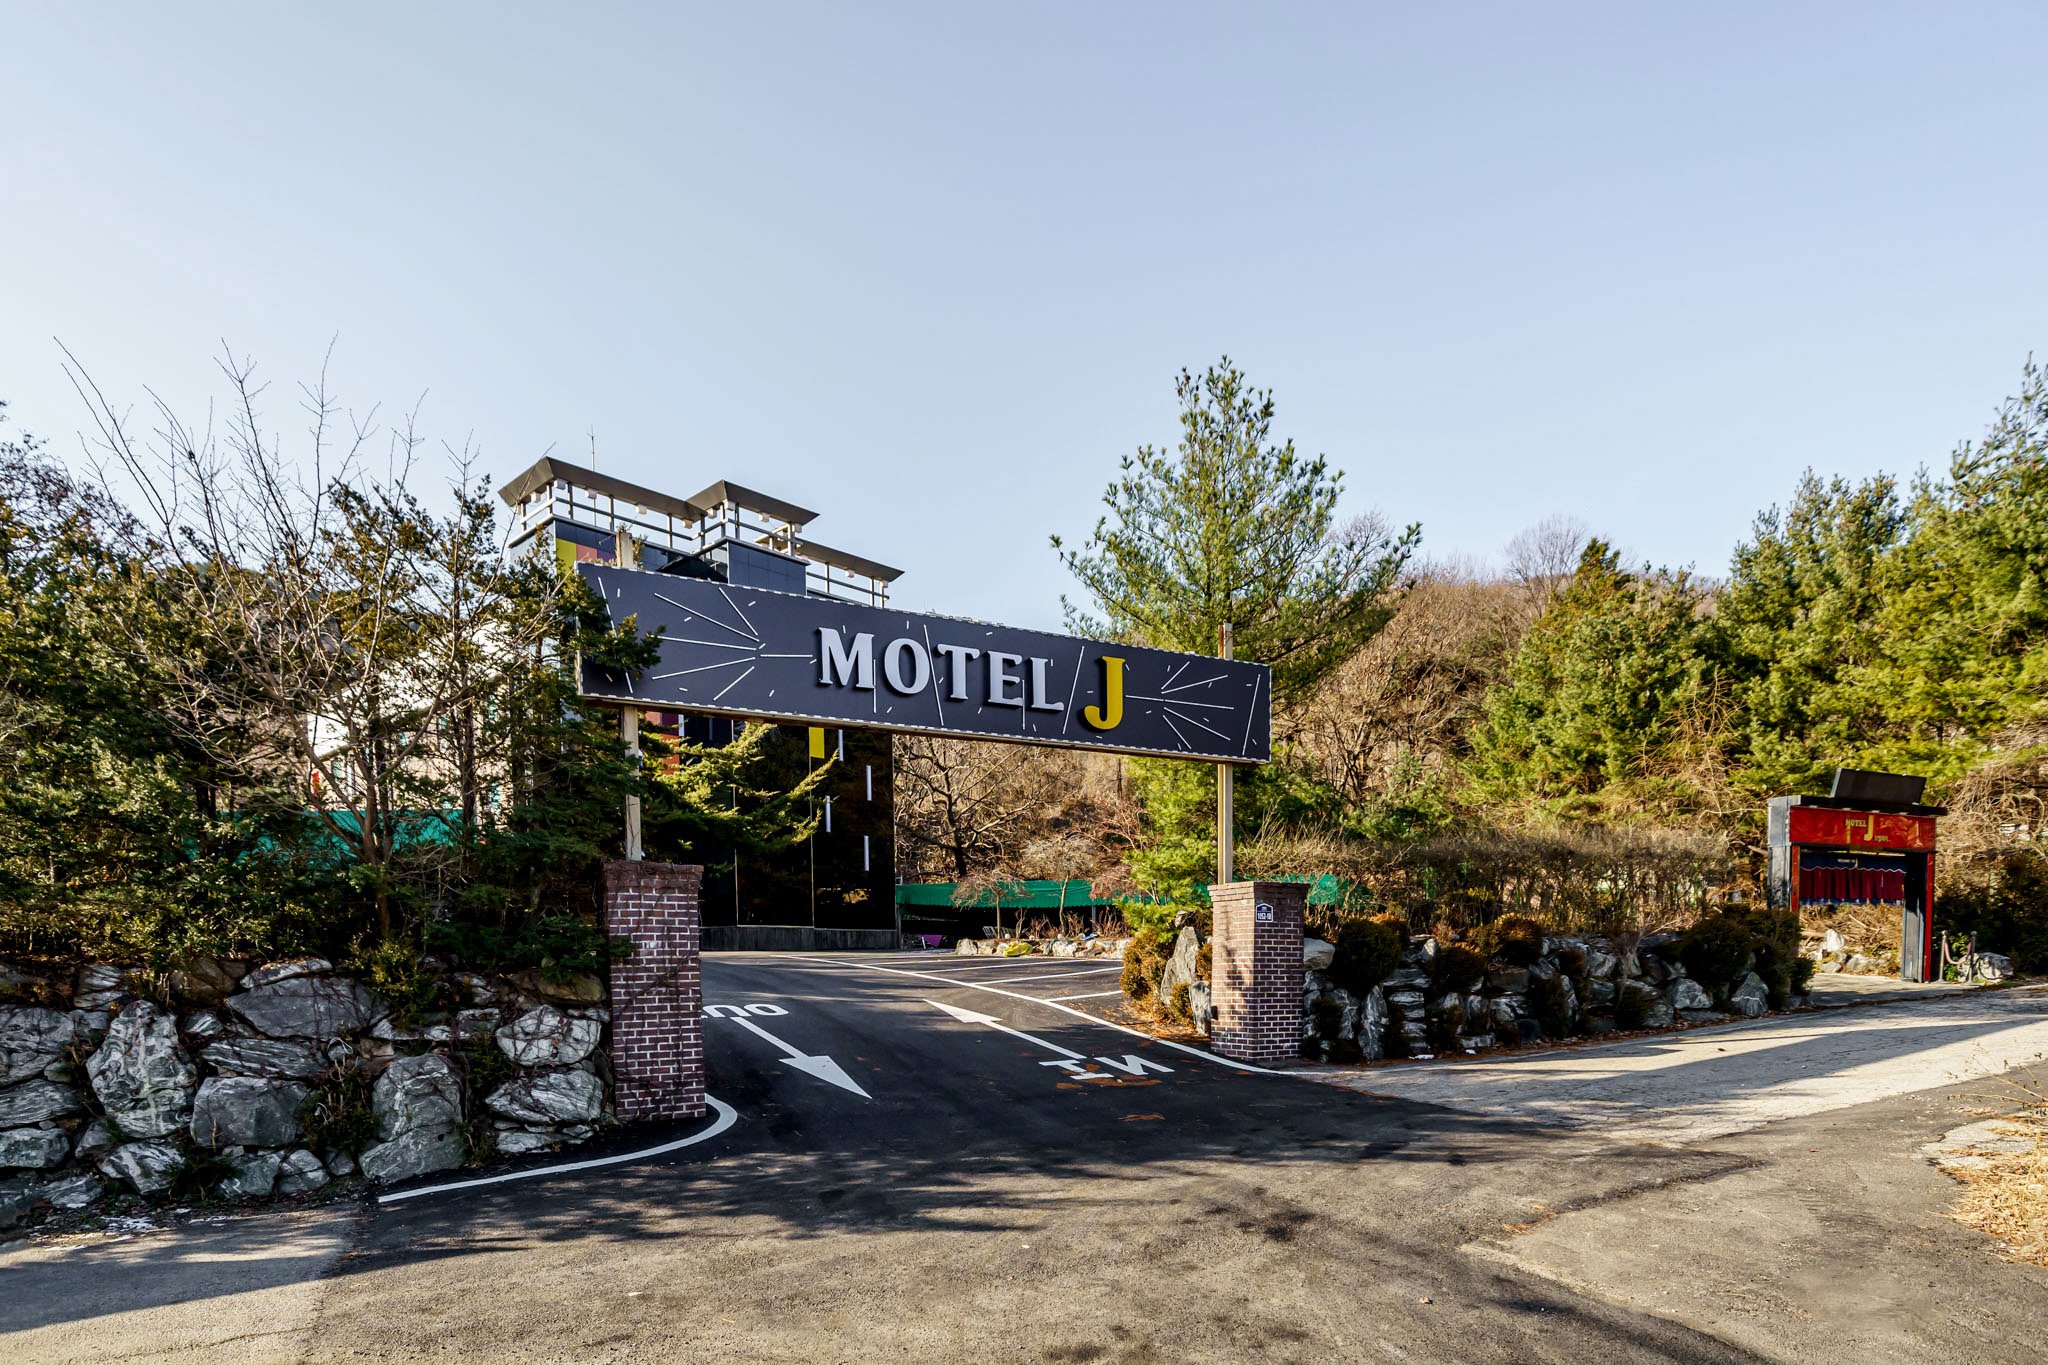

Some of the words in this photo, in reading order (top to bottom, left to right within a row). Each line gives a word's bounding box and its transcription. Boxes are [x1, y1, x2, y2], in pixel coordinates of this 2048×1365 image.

[817, 627, 1065, 711] MOTEL
[1084, 655, 1125, 730] J
[701, 1003, 789, 1018] OU
